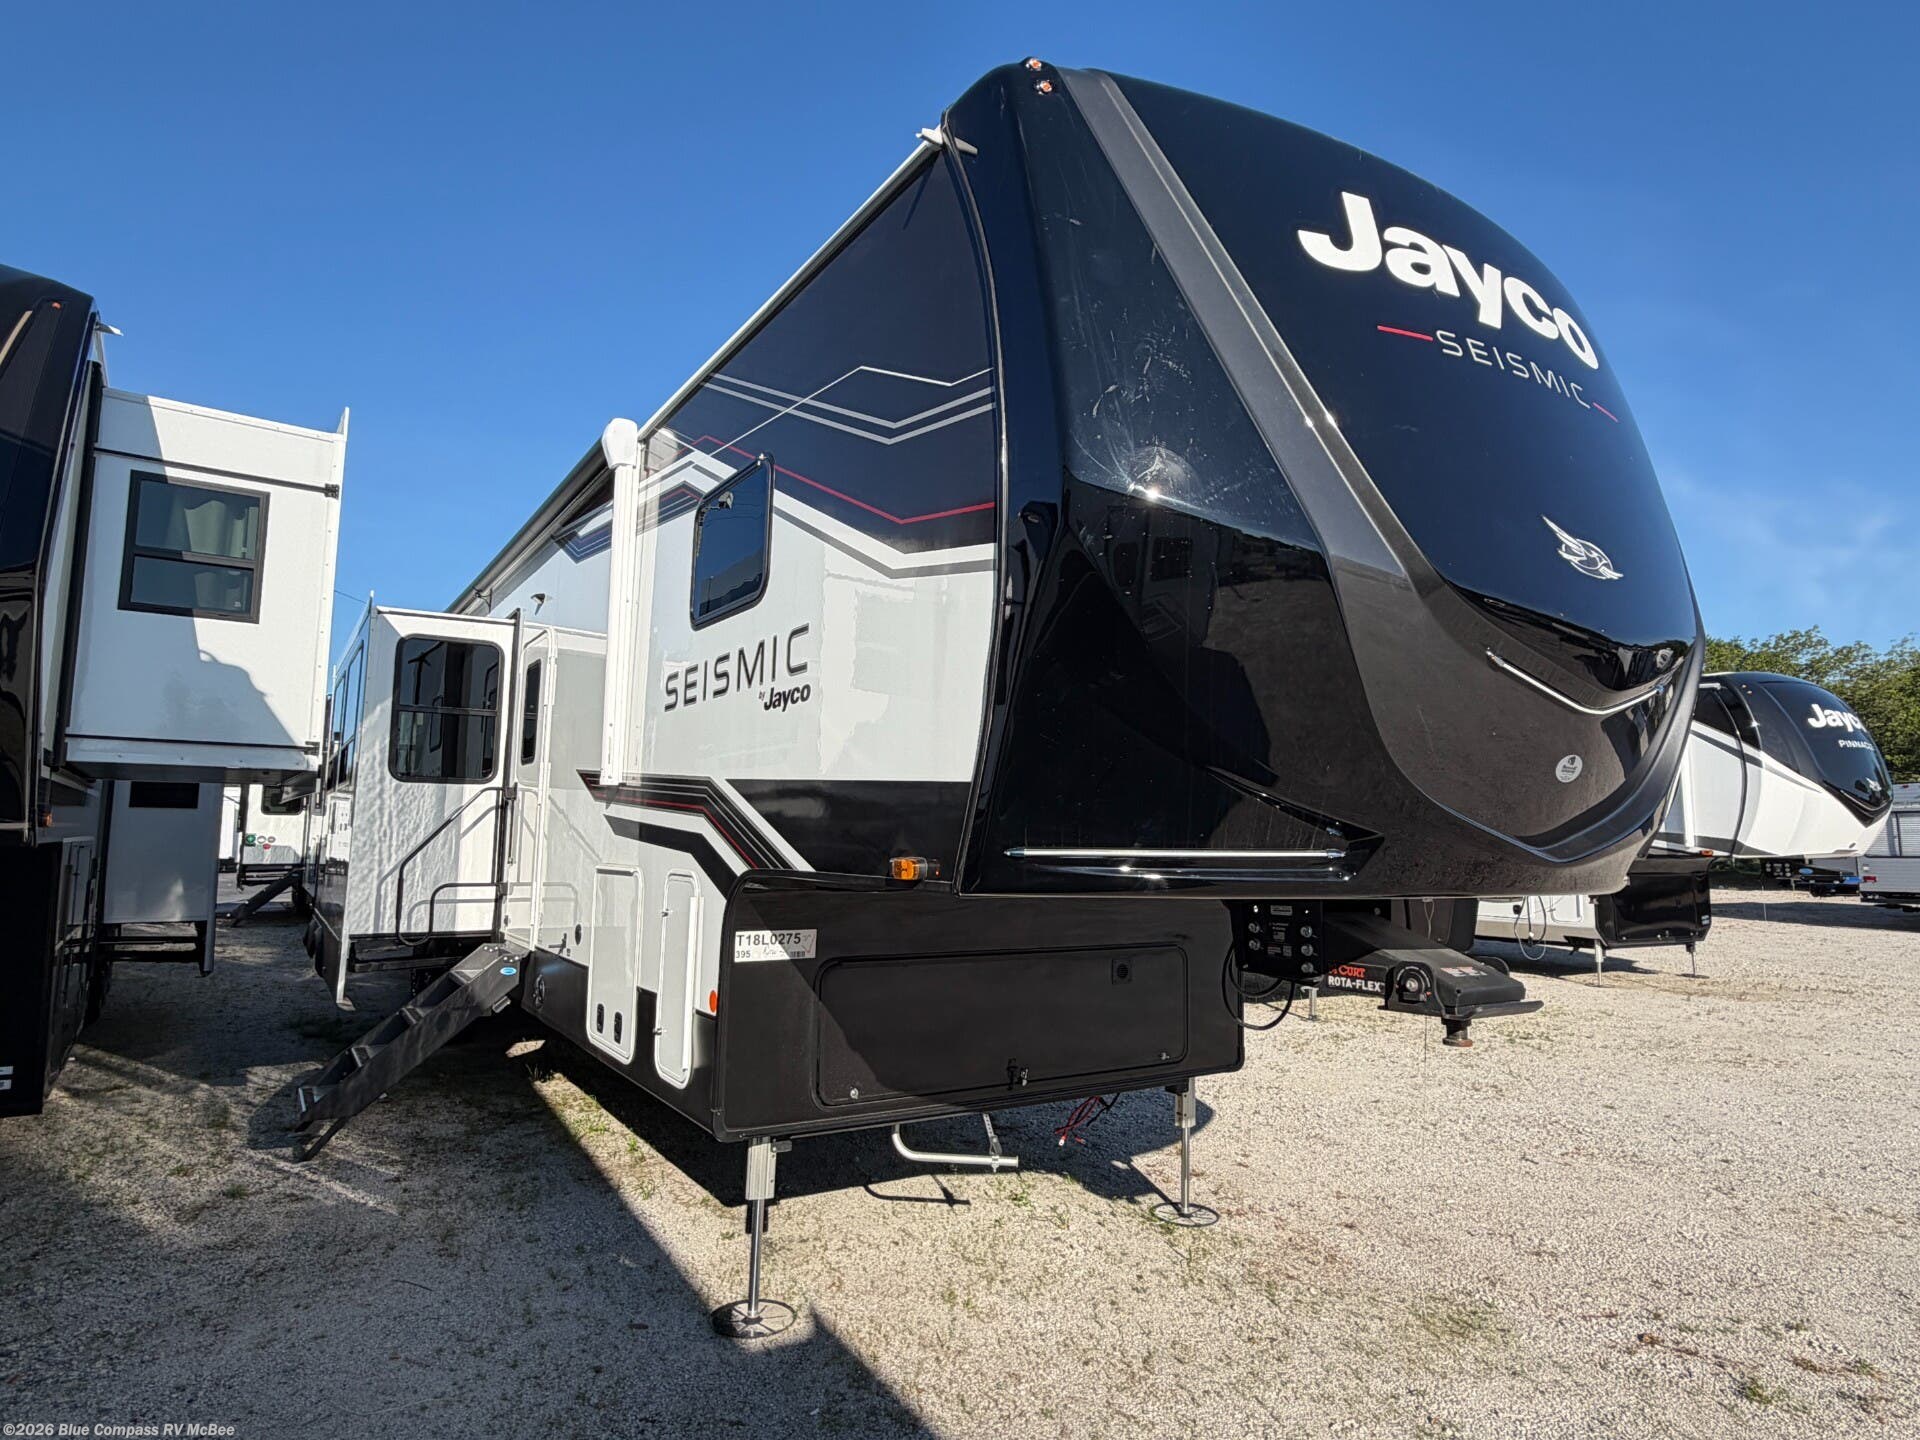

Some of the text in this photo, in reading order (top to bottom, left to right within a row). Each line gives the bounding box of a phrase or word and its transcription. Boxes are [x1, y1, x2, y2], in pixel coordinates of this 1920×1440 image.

[1297, 191, 1599, 369] Jayco
[1436, 330, 1591, 408] SEISMIC
[664, 623, 810, 712] SEISMIC
[763, 684, 811, 712] Jayco
[736, 933, 802, 947] T18L0275
[735, 950, 751, 959] 395
[1338, 965, 1366, 978] CURT
